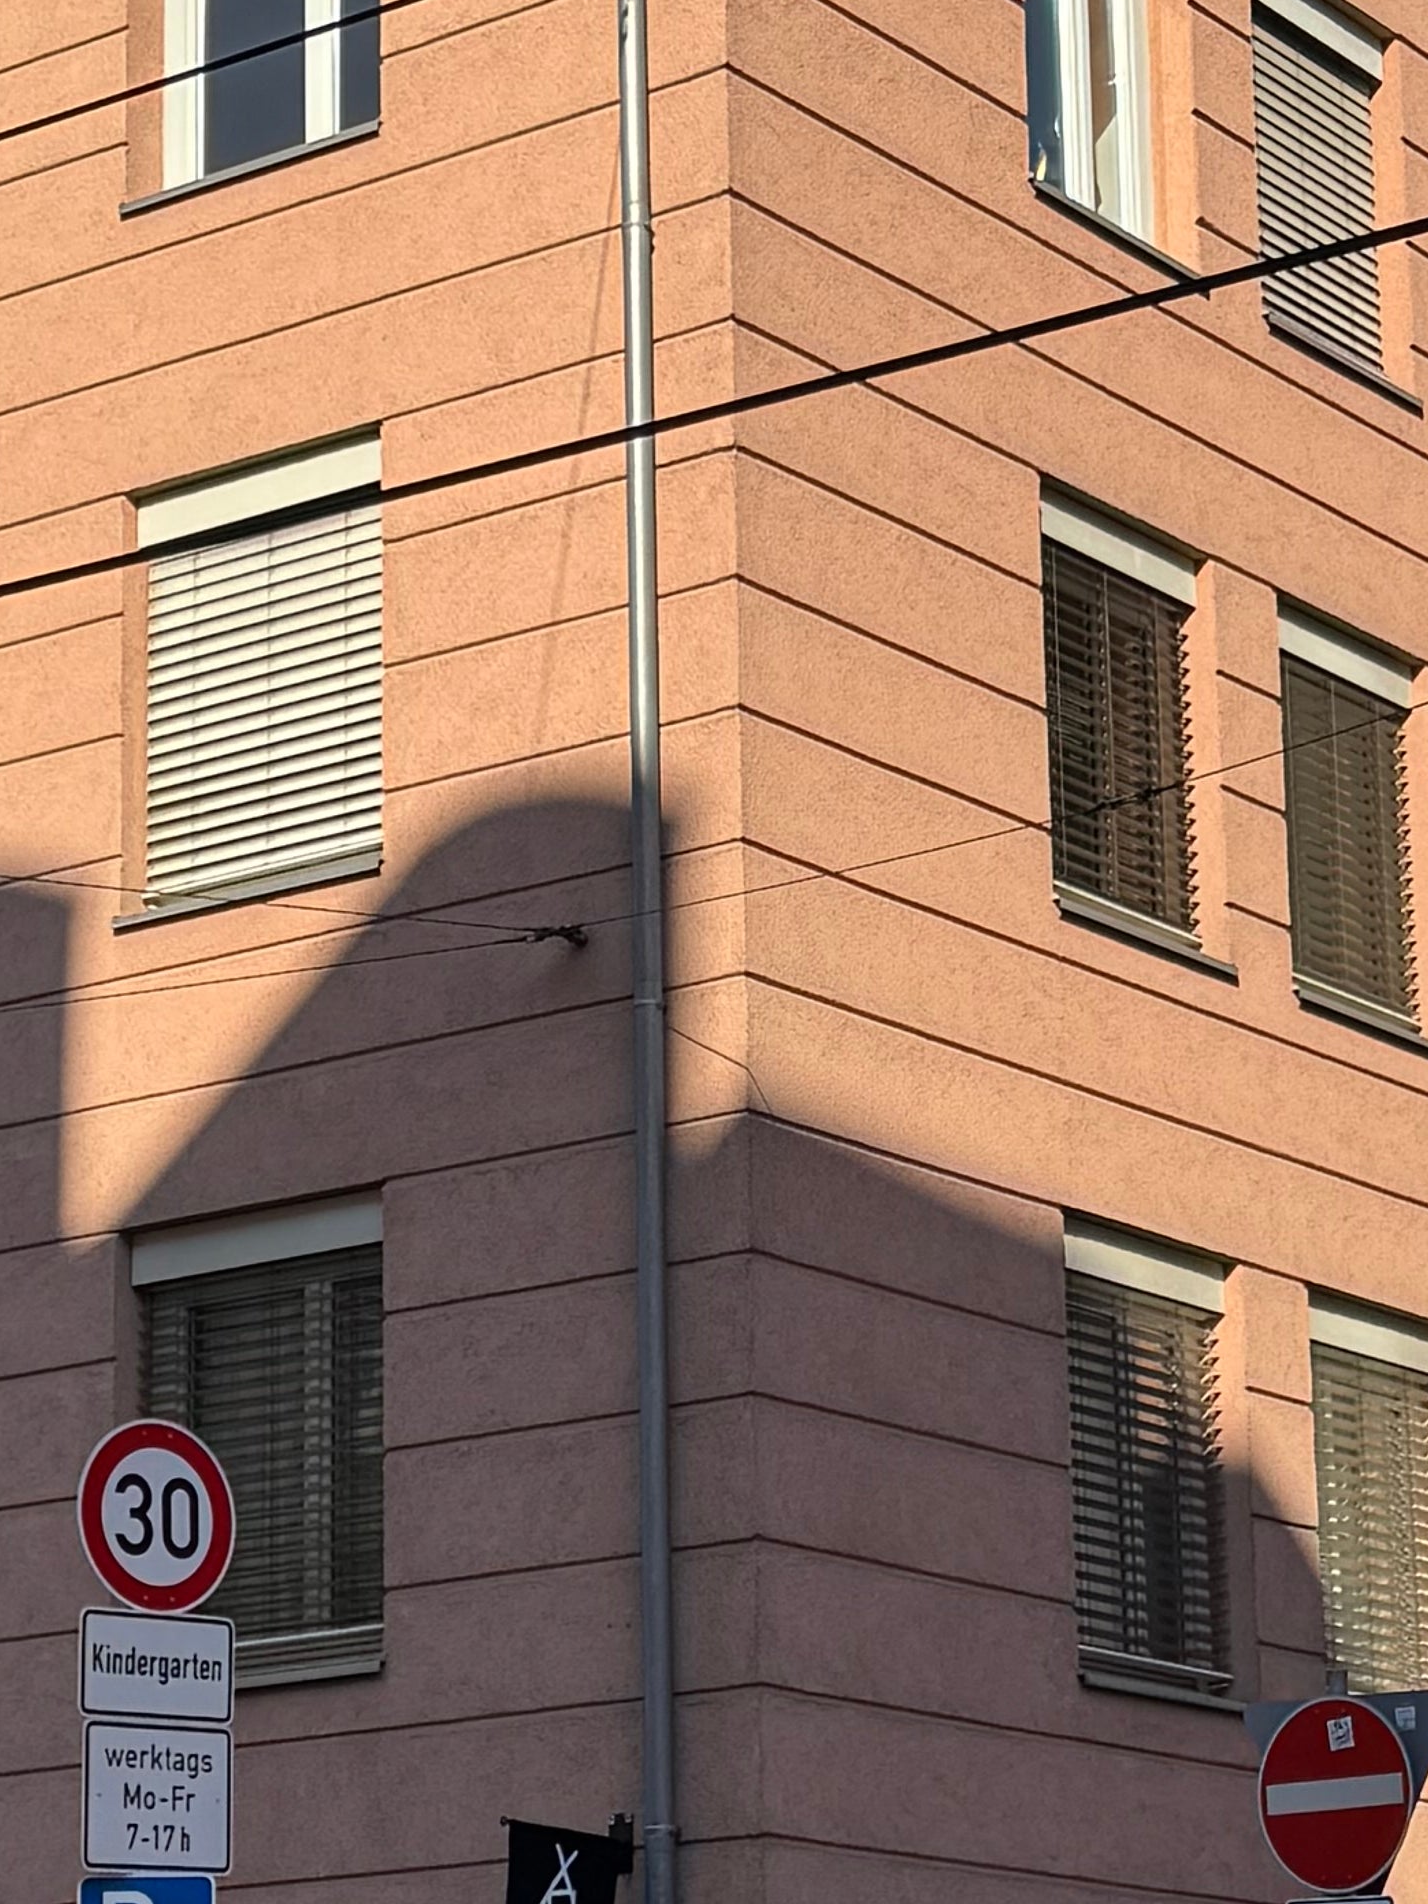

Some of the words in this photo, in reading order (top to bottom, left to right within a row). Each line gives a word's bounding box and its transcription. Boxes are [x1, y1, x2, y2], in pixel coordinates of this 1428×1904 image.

[115, 1473, 200, 1559] 30
[91, 1643, 223, 1685] Kindergarten
[104, 1743, 213, 1778] werktags
[123, 1782, 196, 1813] Mo-Fr
